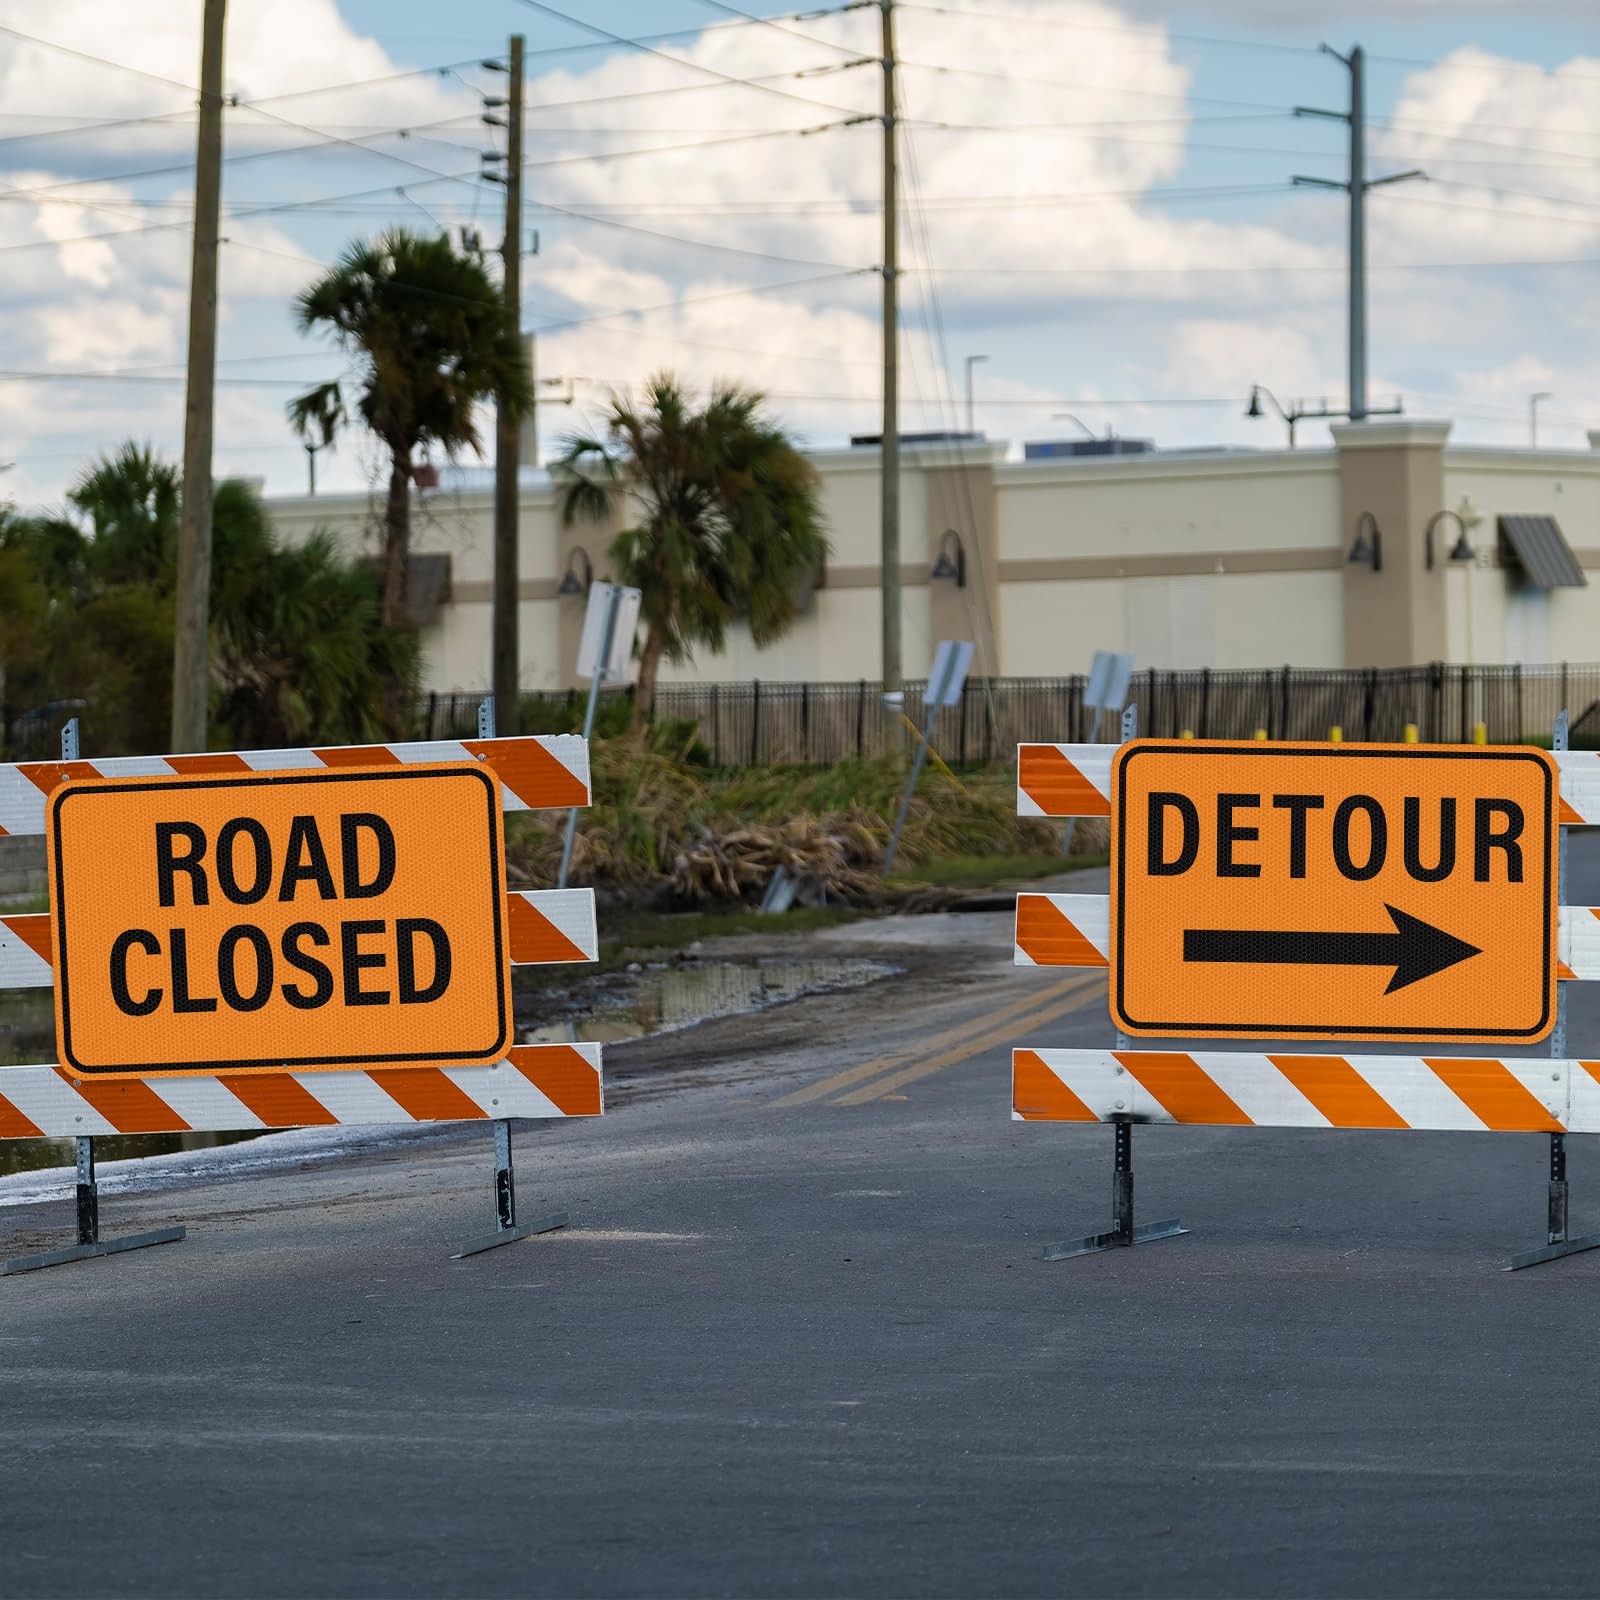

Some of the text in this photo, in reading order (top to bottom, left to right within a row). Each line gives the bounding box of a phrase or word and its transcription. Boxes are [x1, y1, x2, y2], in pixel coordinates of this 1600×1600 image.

[156, 813, 396, 907] ROAD
[1148, 792, 1524, 882] DETOUR
[110, 918, 451, 1016] CLOSED
